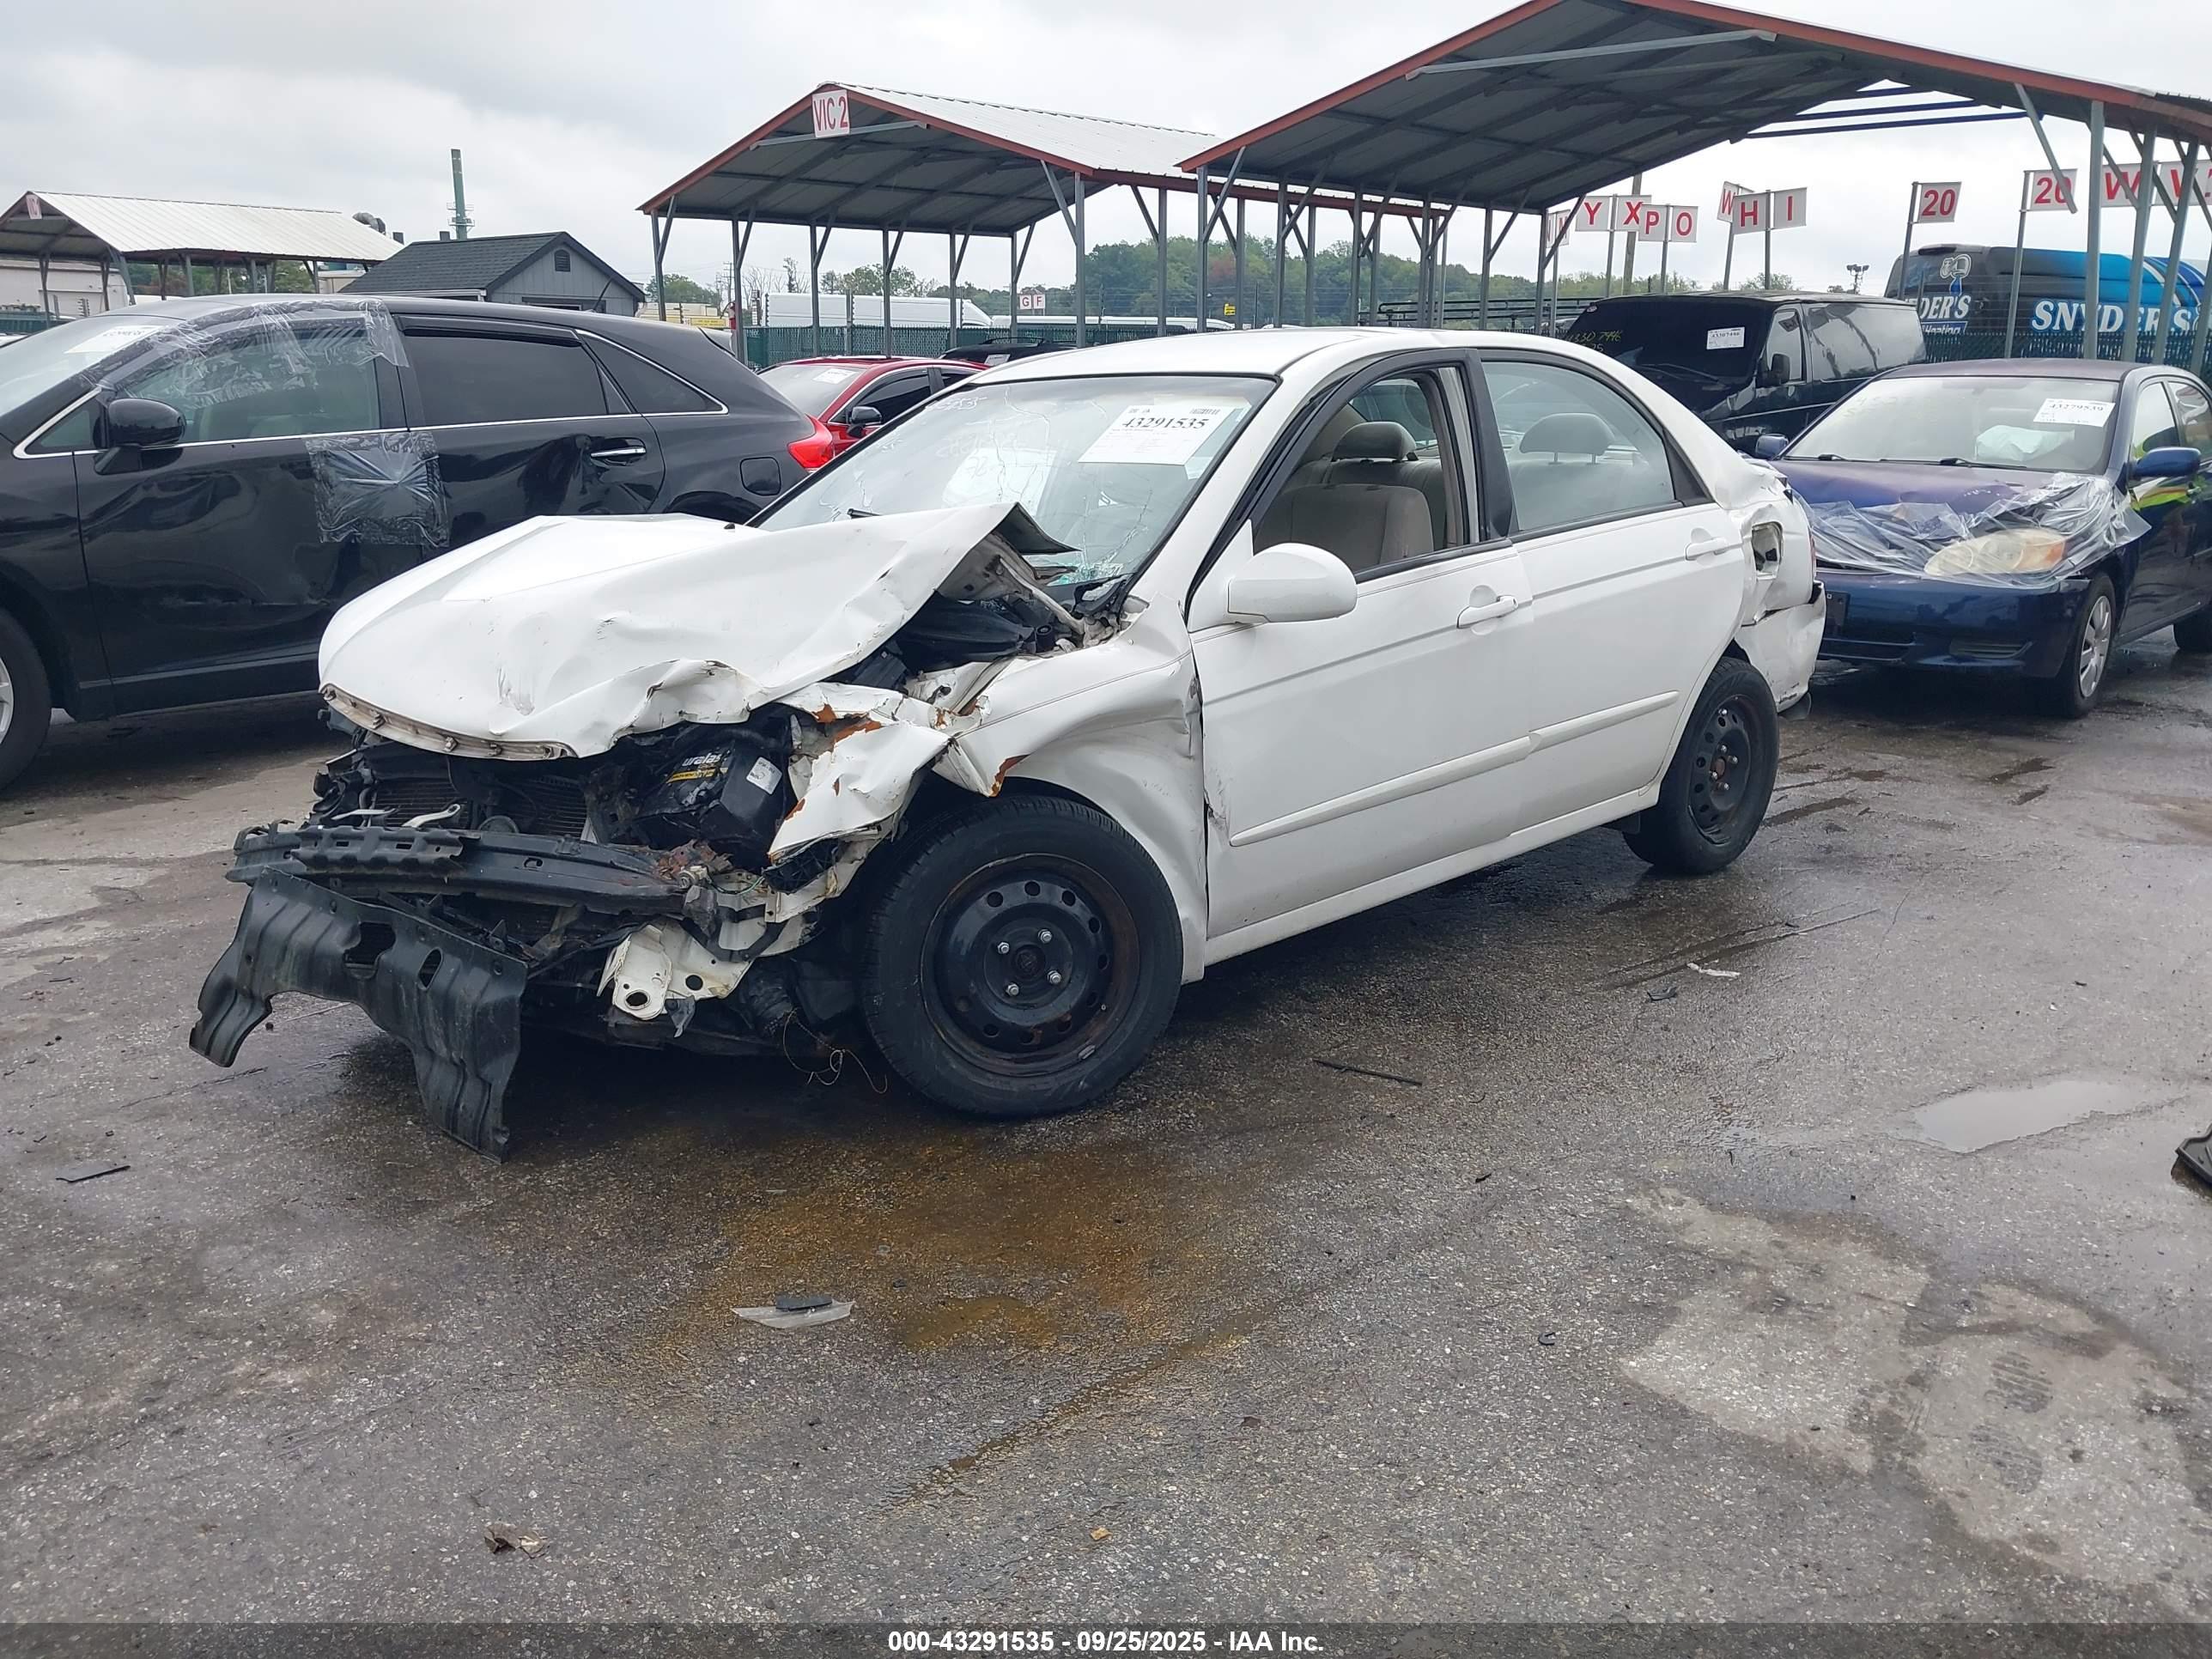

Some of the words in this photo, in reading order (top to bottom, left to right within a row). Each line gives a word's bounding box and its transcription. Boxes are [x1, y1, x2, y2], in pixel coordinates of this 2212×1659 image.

[814, 97, 836, 131] VIC
[838, 96, 848, 128] 2
[1583, 202, 1603, 226] Y
[1623, 202, 1644, 225] X
[1740, 200, 1759, 228] H
[1922, 189, 1956, 216] 20
[1644, 210, 1660, 234] P
[1022, 296, 1030, 307] G
[1036, 296, 1042, 307] F
[1121, 417, 1210, 428] 43291535
